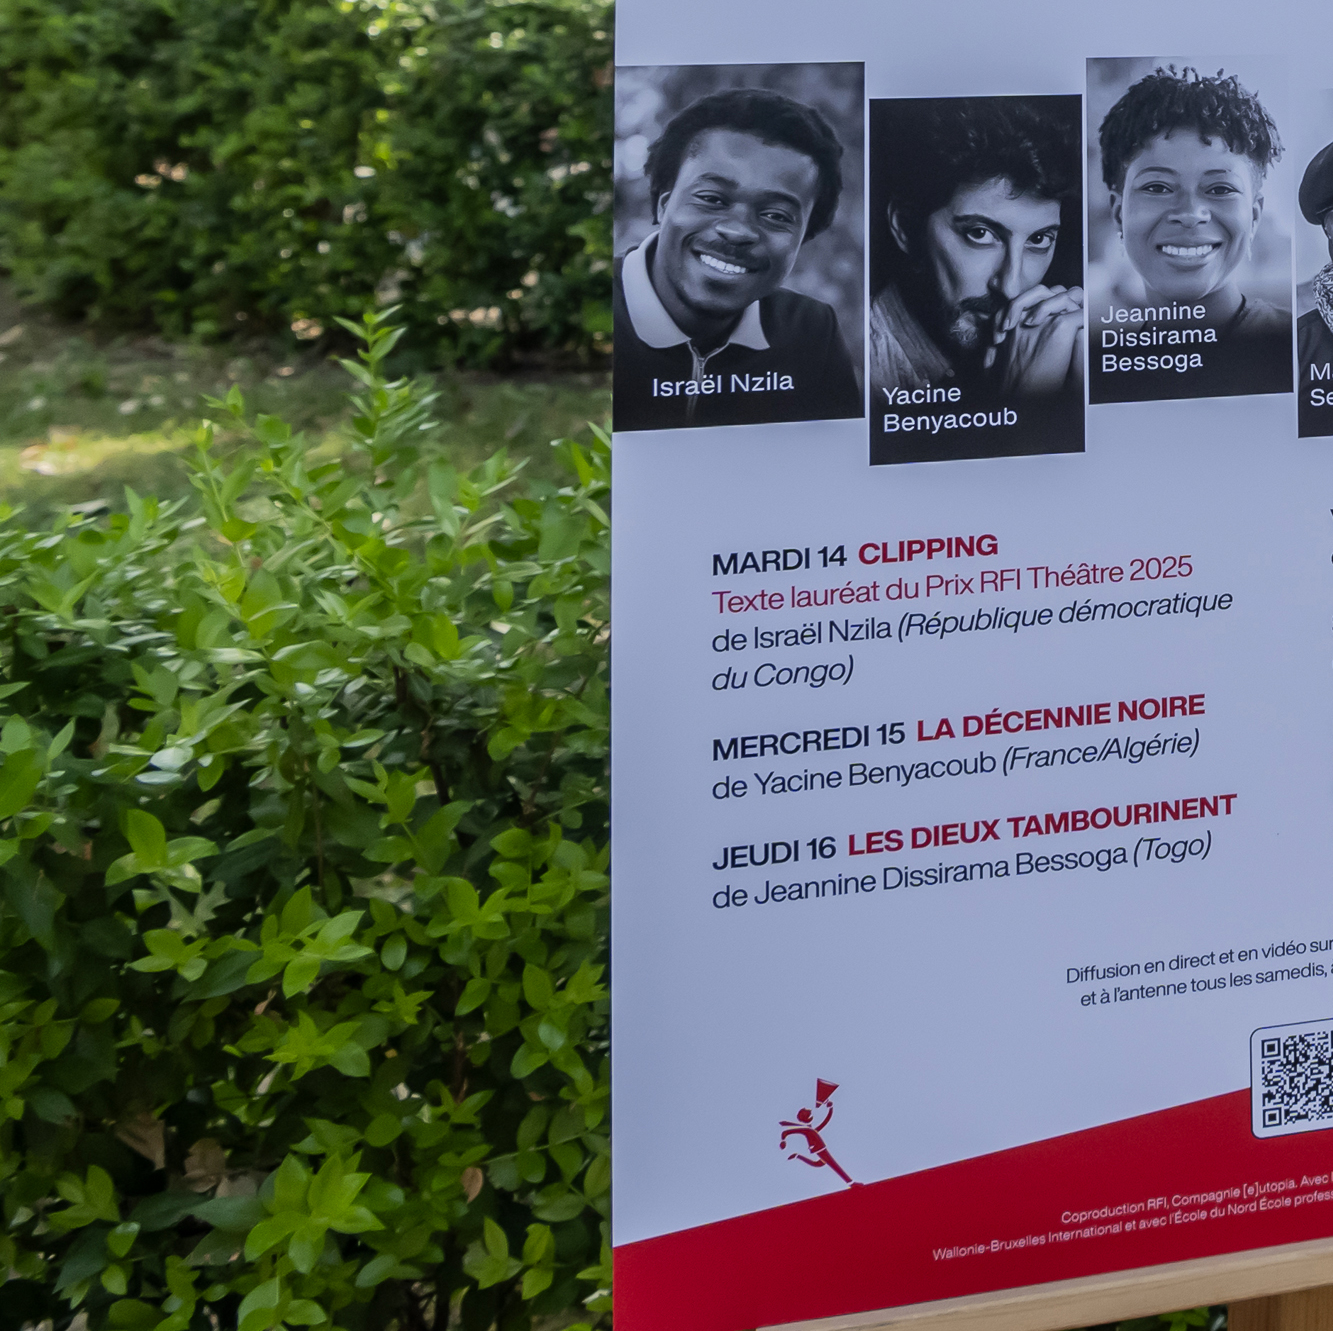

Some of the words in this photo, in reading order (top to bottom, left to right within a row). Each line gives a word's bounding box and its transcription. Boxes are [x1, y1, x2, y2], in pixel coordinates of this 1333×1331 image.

[1101, 303, 1207, 324] Jeannine
[1101, 325, 1218, 349] Dissirama
[651, 374, 722, 397] Israël
[730, 371, 794, 393] Nzila
[1101, 351, 1204, 374] Bessoga
[882, 384, 962, 406] Yacine
[883, 407, 1018, 434] Benyacoub
[713, 548, 809, 575] MARDI
[818, 545, 847, 567] 14
[859, 534, 998, 564] CLIPPING
[712, 590, 784, 613] Texte
[792, 581, 880, 608] lauréat
[886, 578, 918, 600] du
[927, 574, 974, 597] Prix
[981, 569, 1020, 593] RFI
[1027, 563, 1124, 588] Théâtre
[1130, 555, 1192, 581] 2025
[712, 629, 747, 652] de
[755, 622, 821, 648] Israël
[830, 617, 892, 642] Nzila
[898, 607, 1053, 642] (République
[1059, 593, 1232, 623] démocratique
[712, 667, 747, 690] du
[754, 655, 853, 688] Congo)
[713, 725, 869, 761] MERCREDI
[877, 722, 905, 745] 15
[918, 718, 955, 741] LA
[963, 703, 1111, 737] DÉCENNIE
[1119, 694, 1205, 722] NOIRE
[713, 776, 747, 799] de
[754, 769, 842, 794] Yacine
[850, 751, 996, 787] Benyacoub
[1003, 728, 1199, 776] (France/Algérie)
[713, 840, 798, 870] JEUDI
[807, 837, 836, 859] 16
[849, 830, 903, 855] LES
[912, 819, 1000, 849] DIEUX
[1007, 794, 1237, 838] TAMBOURINENT
[713, 885, 748, 908] de
[754, 874, 876, 904] Jeannine
[884, 861, 1010, 890] Dissirama
[1016, 848, 1128, 875] Bessoga
[1134, 830, 1211, 867] (Togo)
[1067, 963, 1140, 983] Diffusion
[1144, 961, 1164, 973] en
[1169, 952, 1215, 970] direct
[1219, 949, 1234, 964] et
[1238, 949, 1258, 961] en
[1262, 940, 1306, 958] vidéo
[1081, 991, 1096, 1006] et
[1100, 989, 1110, 1004] à
[1114, 983, 1187, 1002] l'antenne
[1191, 978, 1226, 992] tous
[1230, 973, 1252, 987] les
[1256, 963, 1327, 983] samedis,
[1062, 1203, 1144, 1223] Coproduction
[1147, 1197, 1169, 1210] RFI,
[1172, 1187, 1240, 1207] Compagnie
[1300, 1175, 1328, 1187] Avec
[933, 1235, 1046, 1260] Wallonie-Bruxelles
[1049, 1221, 1122, 1242] International
[1125, 1220, 1136, 1231] et
[1139, 1217, 1167, 1229] avec
[1210, 1207, 1225, 1218] du
[1228, 1201, 1257, 1215] Nord
[1259, 1196, 1291, 1210] École
